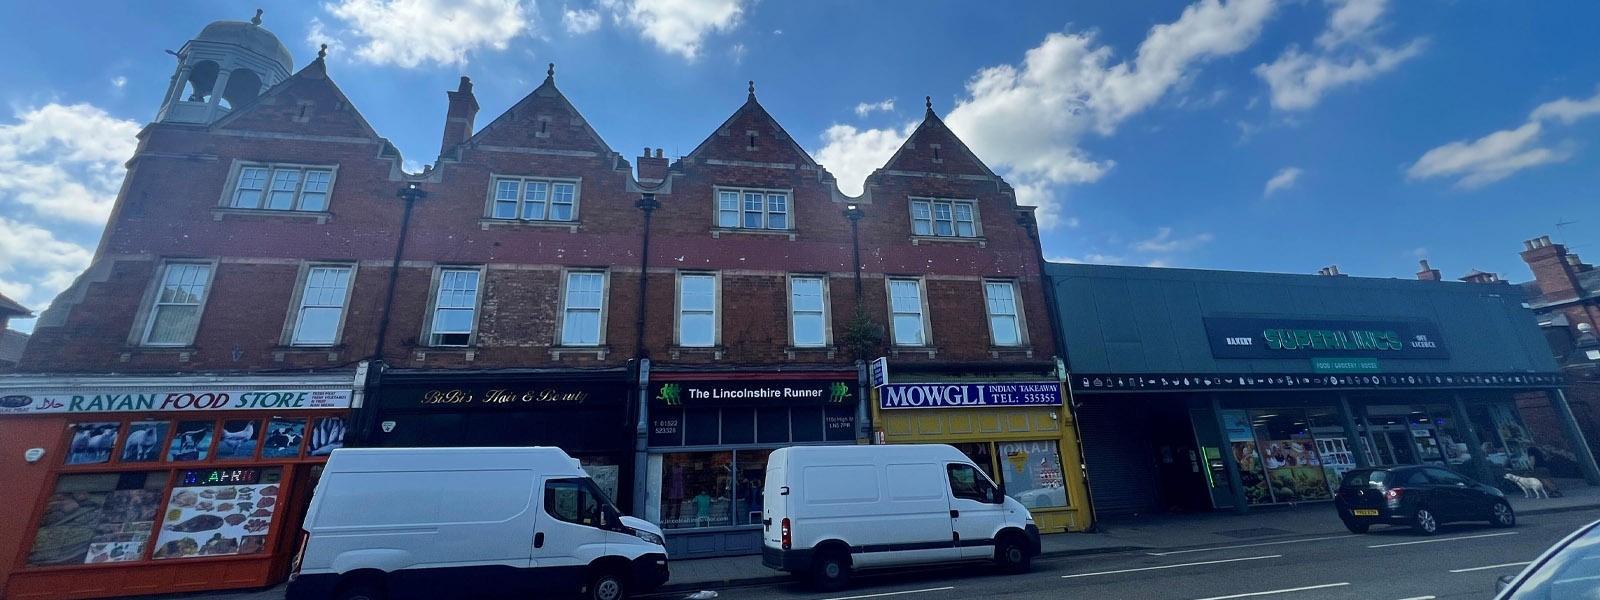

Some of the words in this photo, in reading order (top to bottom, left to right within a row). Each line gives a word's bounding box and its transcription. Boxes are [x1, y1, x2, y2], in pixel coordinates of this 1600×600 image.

[1226, 337, 1252, 345] BAKERY
[1263, 329, 1403, 350] SUPERLINCS
[688, 388, 709, 399] The
[713, 388, 781, 399] Lincolnshire
[784, 387, 823, 398] Runner
[989, 385, 1017, 393] INDIAN
[1018, 384, 1058, 393] TAKEAWAY
[68, 394, 156, 412] RAYAN
[160, 392, 231, 410] FOOD
[235, 391, 309, 408] STORE
[420, 389, 473, 404] BiBi's
[482, 389, 517, 404] Hair
[522, 391, 534, 402] &
[536, 388, 588, 404] Beauty
[886, 385, 987, 407] MOWGLI
[991, 394, 1019, 403] TEL:
[1024, 393, 1055, 403] 535355
[35, 397, 65, 410] حلال
